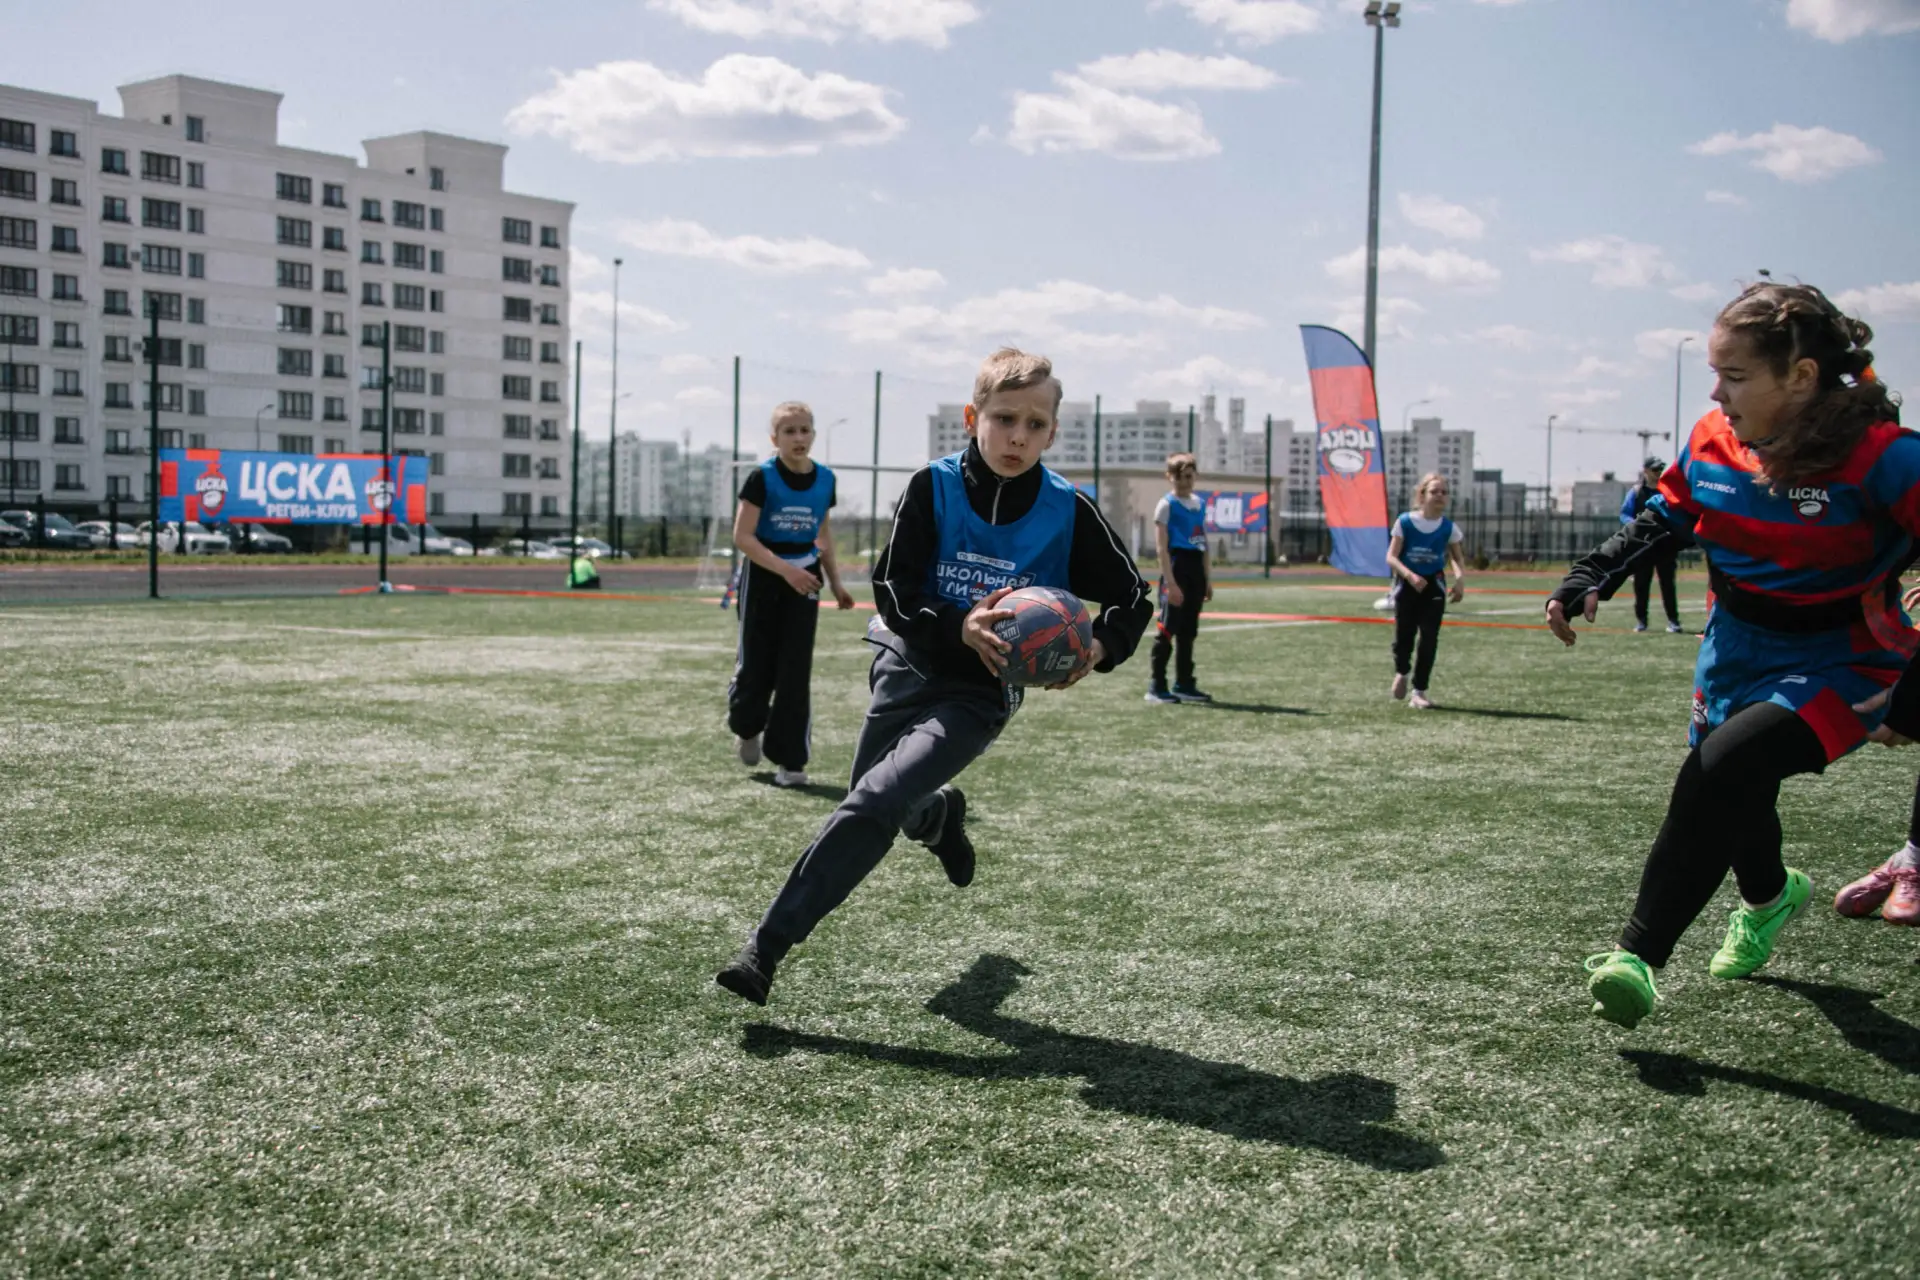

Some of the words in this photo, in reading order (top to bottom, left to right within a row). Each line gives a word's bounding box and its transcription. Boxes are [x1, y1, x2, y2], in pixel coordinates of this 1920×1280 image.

[195, 478, 228, 492] ЦСКА
[239, 460, 356, 506] ЦСКА
[365, 481, 395, 494] ЦСА
[1703, 481, 1737, 495] PATRICK
[1787, 487, 1831, 503] ЦСКА
[266, 503, 359, 519] РЕГБИ-КЛУБ
[969, 587, 989, 597] ЦСКА
